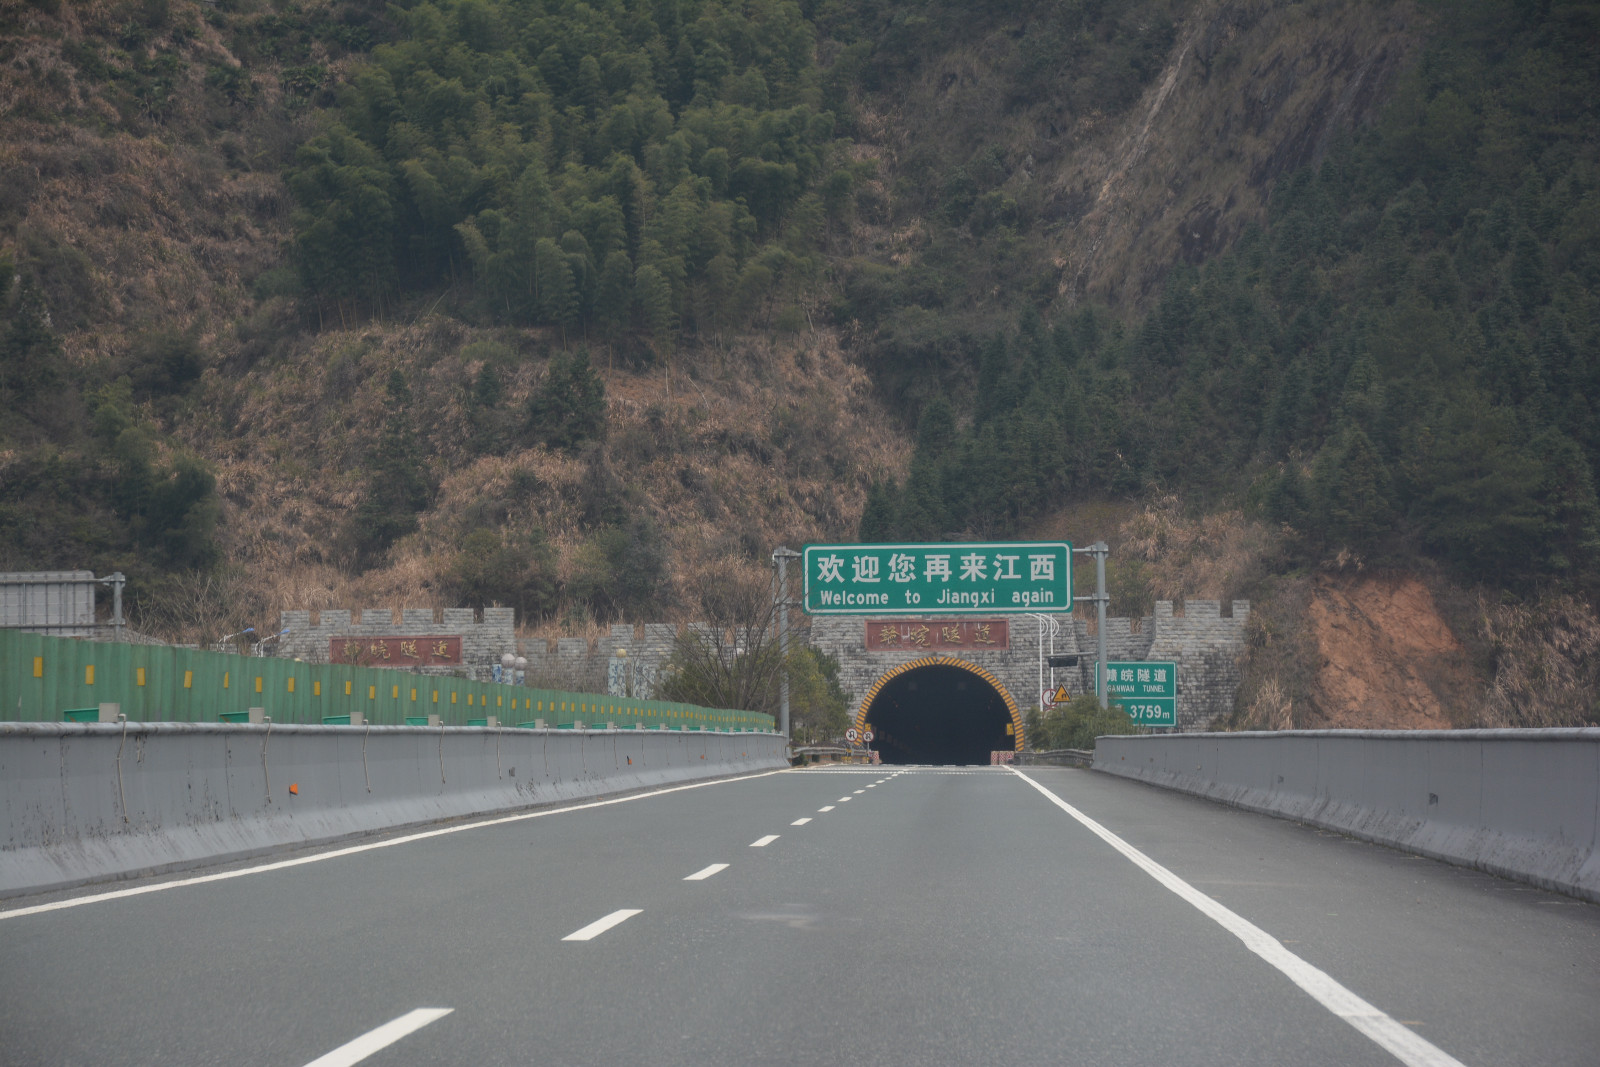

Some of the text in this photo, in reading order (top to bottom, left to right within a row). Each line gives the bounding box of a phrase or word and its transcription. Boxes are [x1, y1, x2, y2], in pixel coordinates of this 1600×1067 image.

[817, 553, 1056, 584] 欢迎您再来江西
[820, 587, 1054, 608] Welcome to Jiangxi again
[1107, 684, 1165, 693] GANWAN TUNNEL
